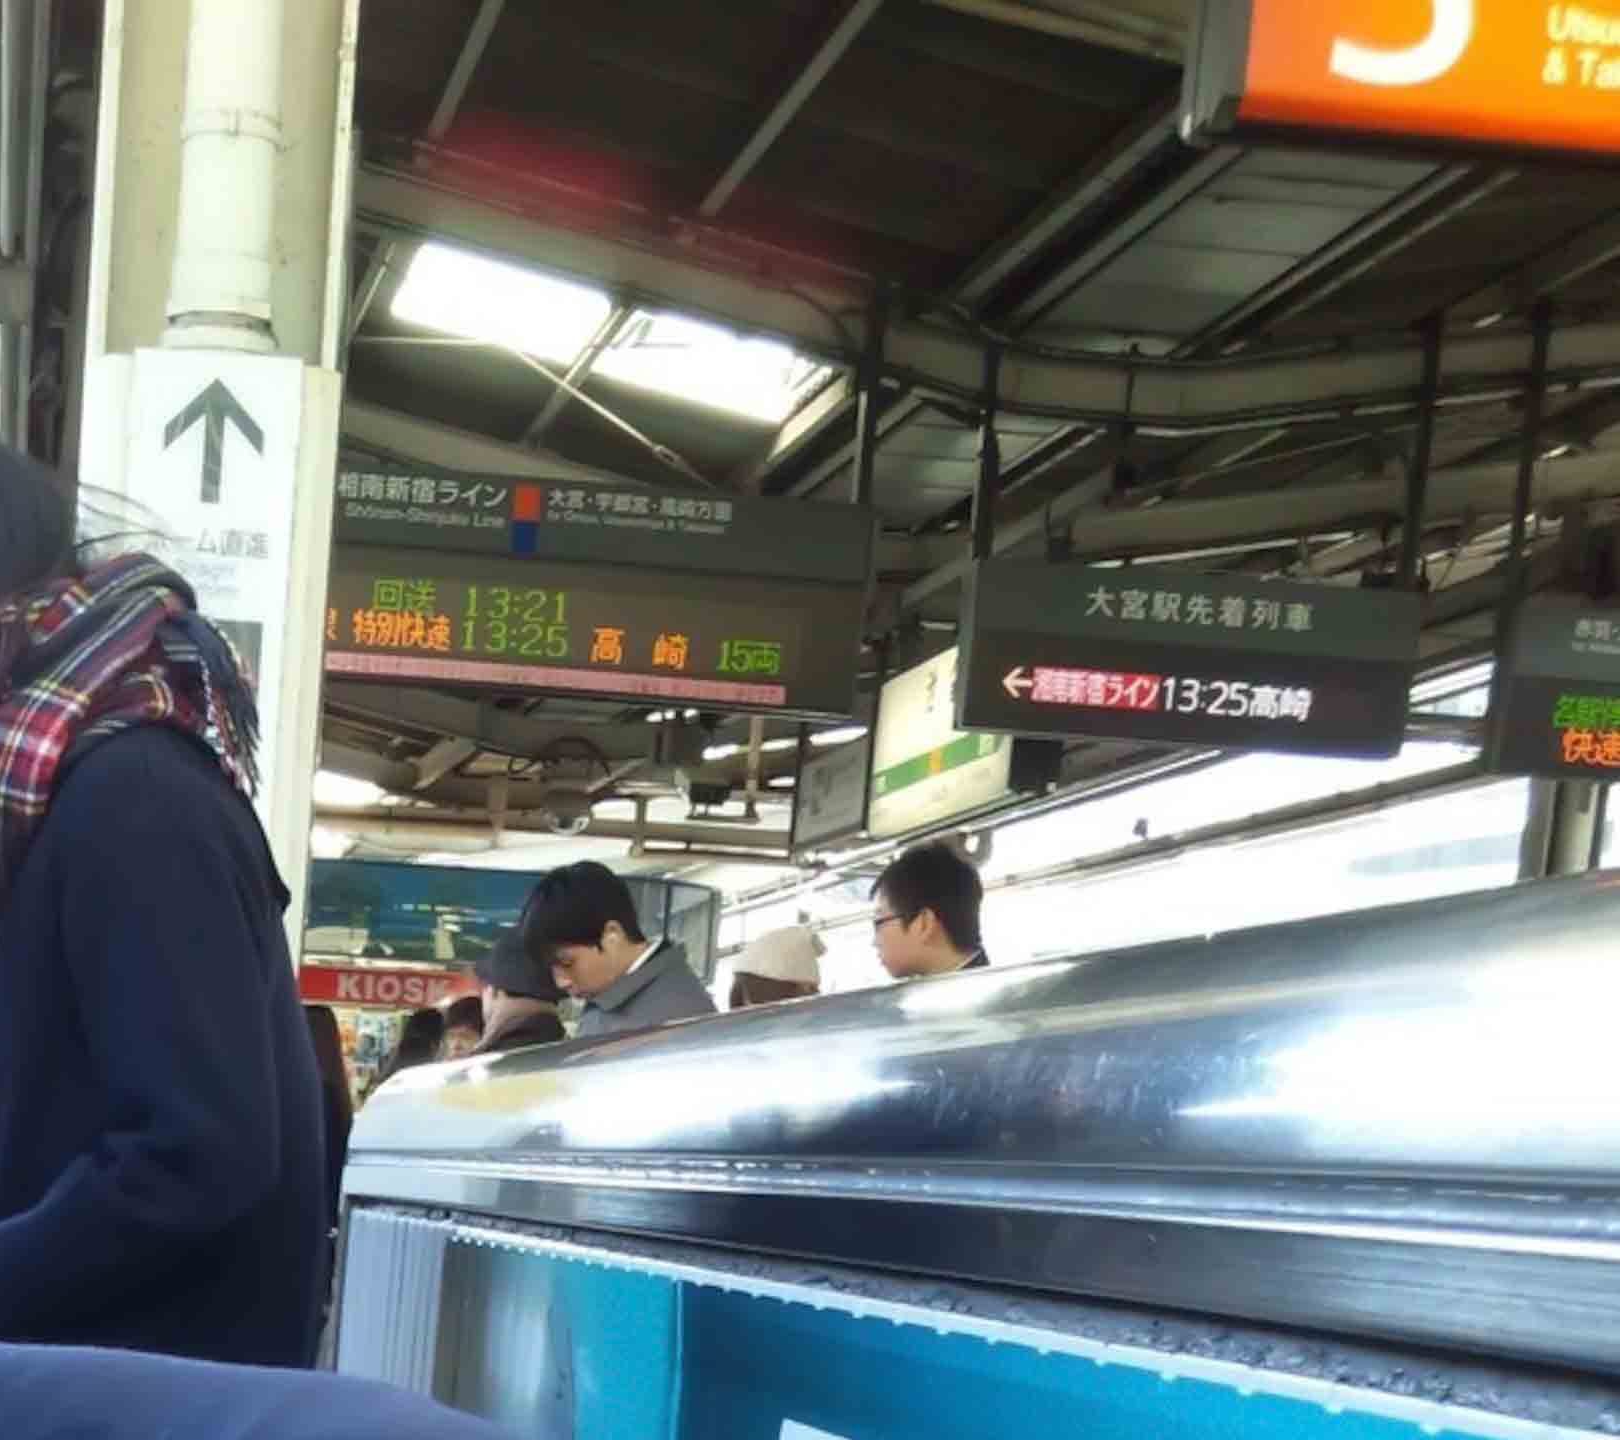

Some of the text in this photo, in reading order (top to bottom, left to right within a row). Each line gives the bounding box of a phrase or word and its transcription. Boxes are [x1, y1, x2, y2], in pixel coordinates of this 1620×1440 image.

[465, 585, 567, 626] 13:21
[1084, 586, 1315, 633] 大宮駅先着列車
[462, 618, 569, 658] 13:25
[336, 972, 451, 1003] KIOSK
